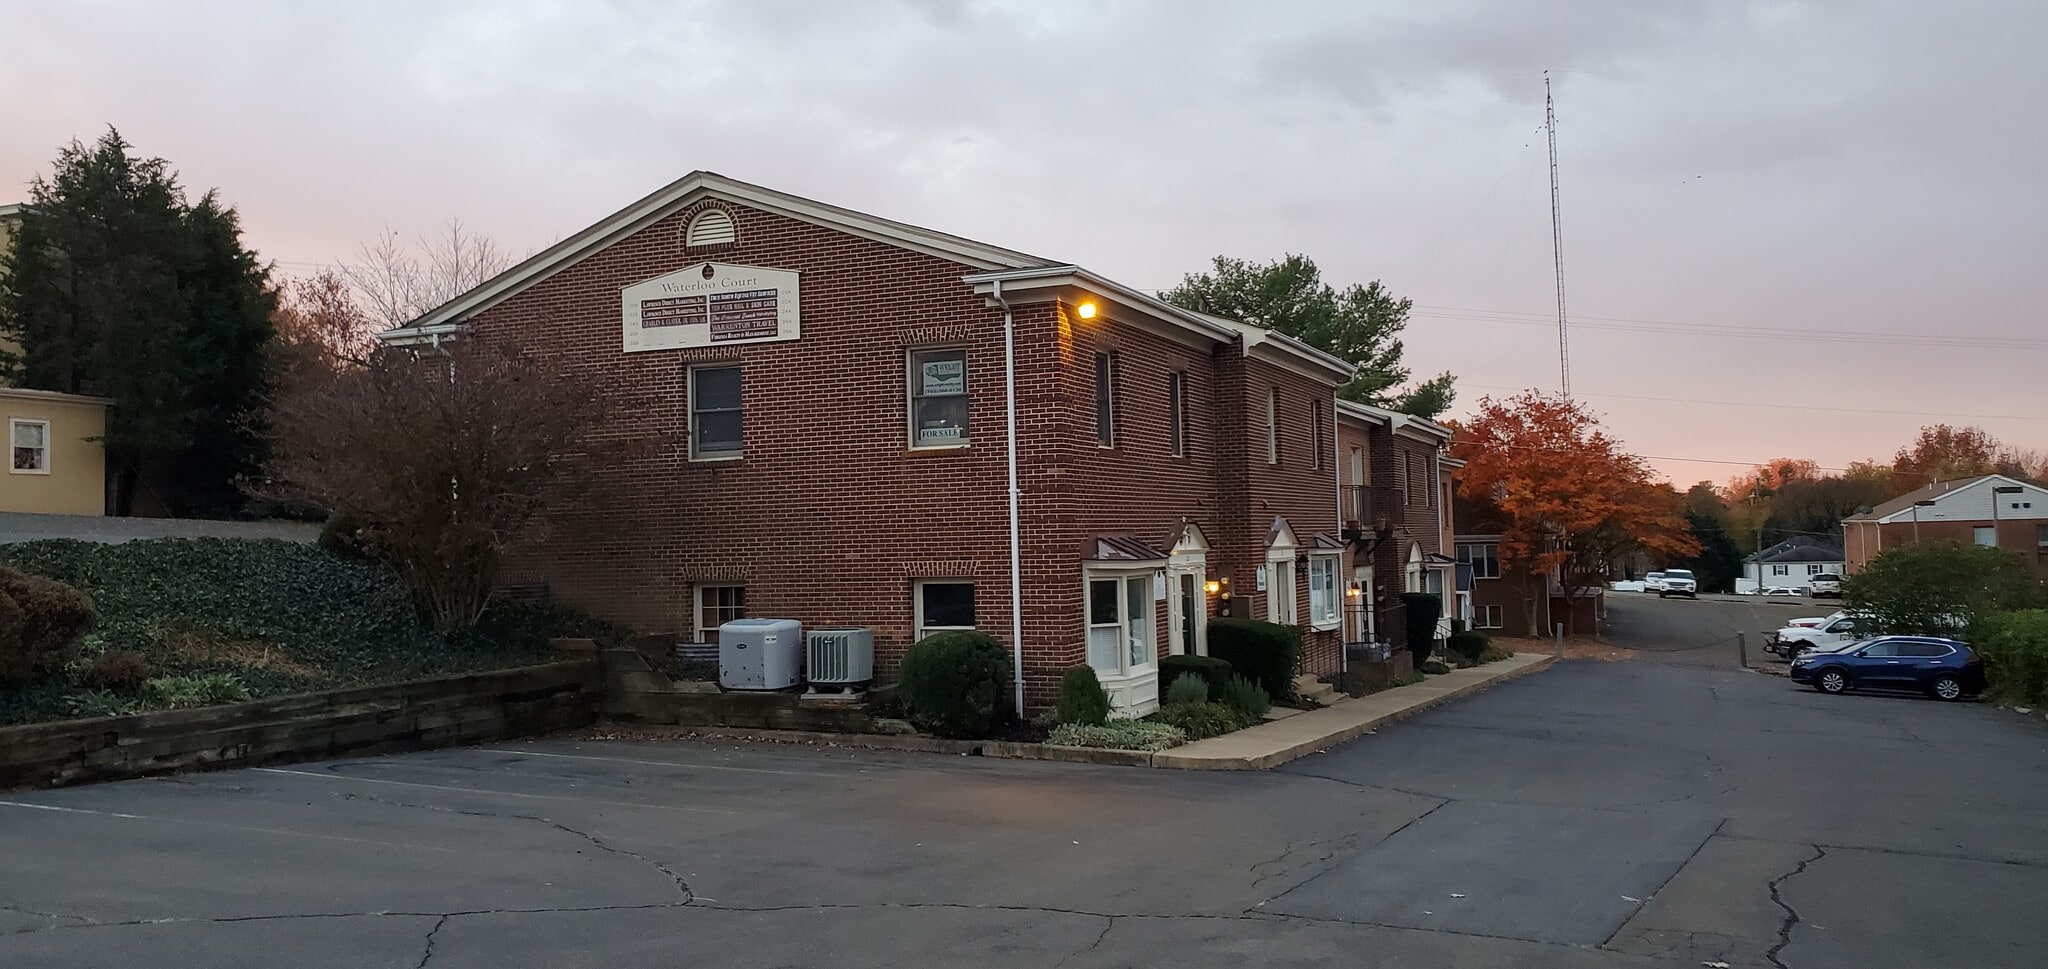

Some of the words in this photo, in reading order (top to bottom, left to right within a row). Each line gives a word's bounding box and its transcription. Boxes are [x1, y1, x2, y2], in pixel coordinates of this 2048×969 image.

[662, 281, 716, 293] Waterloo
[721, 277, 757, 288] Court
[711, 321, 751, 332] WARRENTON
[751, 319, 776, 327] TRAVEL
[922, 430, 938, 438] FOR
[938, 429, 959, 437] SALE
